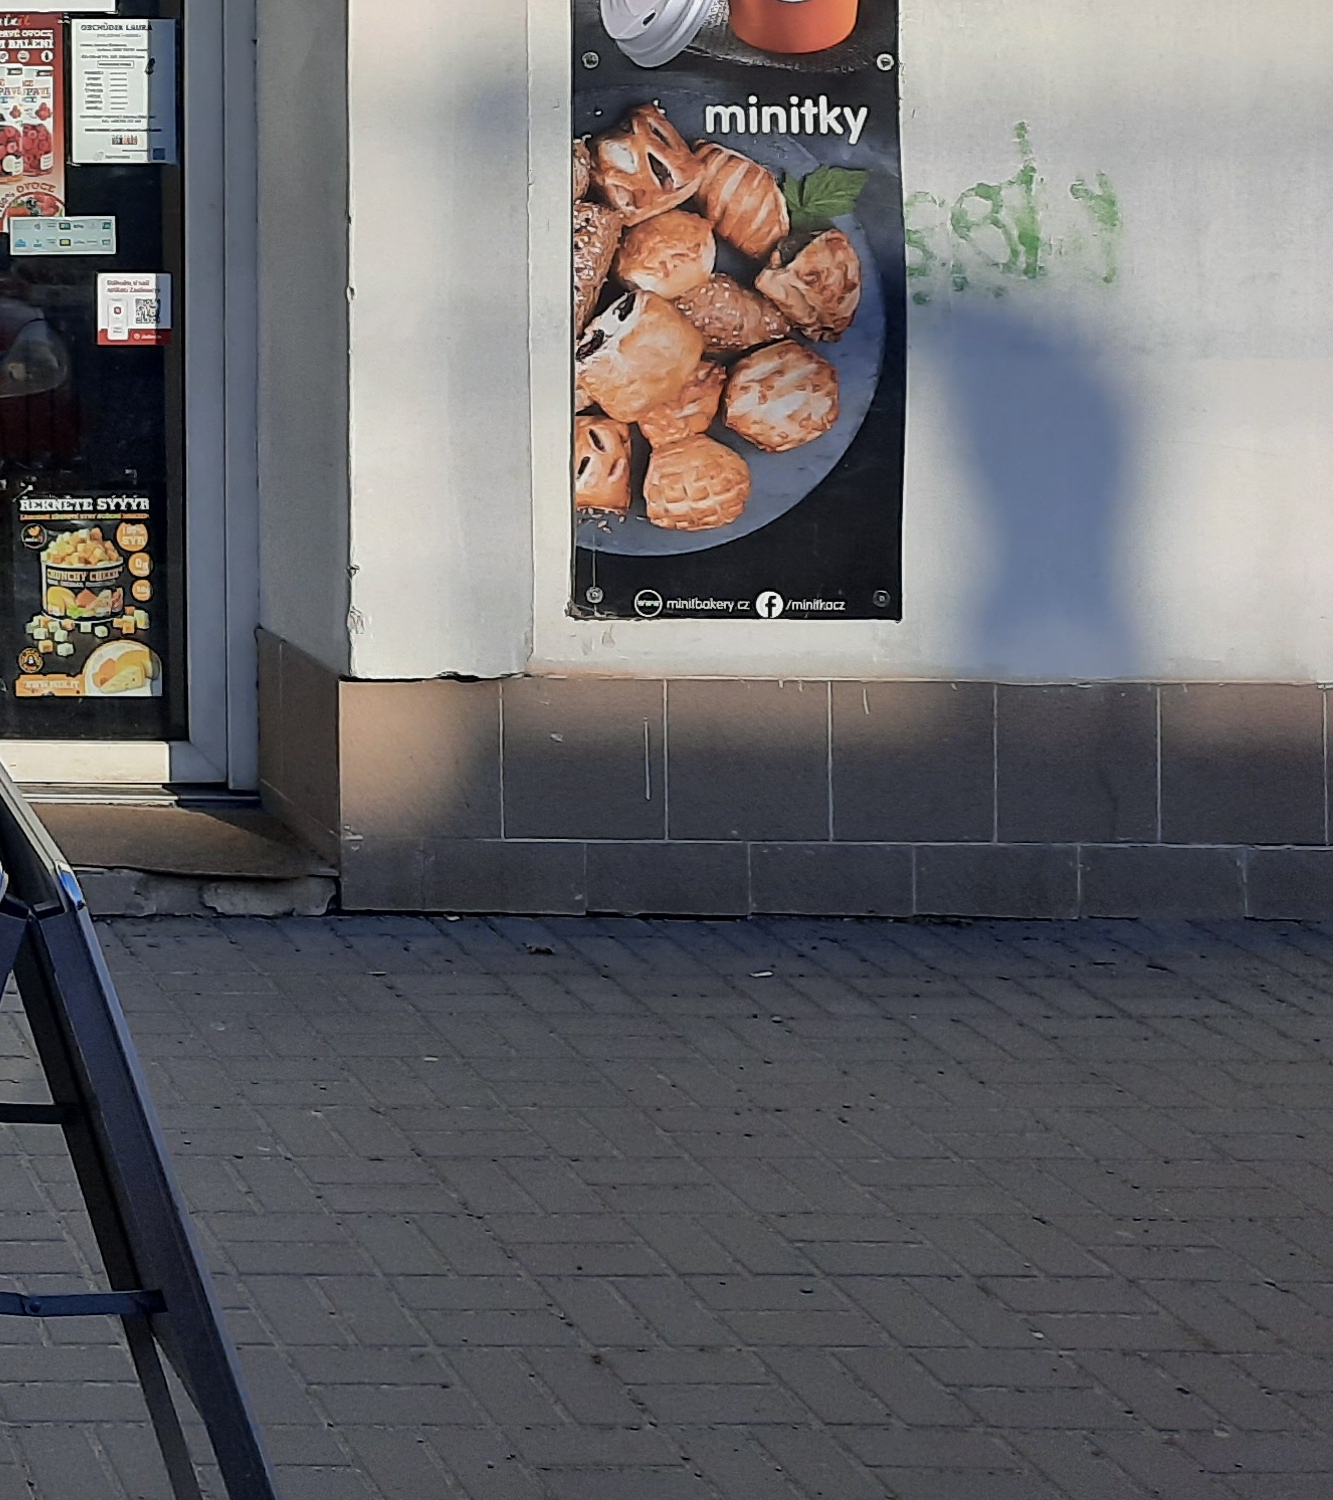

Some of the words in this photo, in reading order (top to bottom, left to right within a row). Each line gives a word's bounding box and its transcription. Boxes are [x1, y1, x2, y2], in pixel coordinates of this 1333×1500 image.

[705, 97, 868, 145] minitky
[16, 182, 56, 193] OVOCE
[20, 496, 93, 511] ŘEKNĚTE
[96, 495, 150, 510] SÝÝÝR
